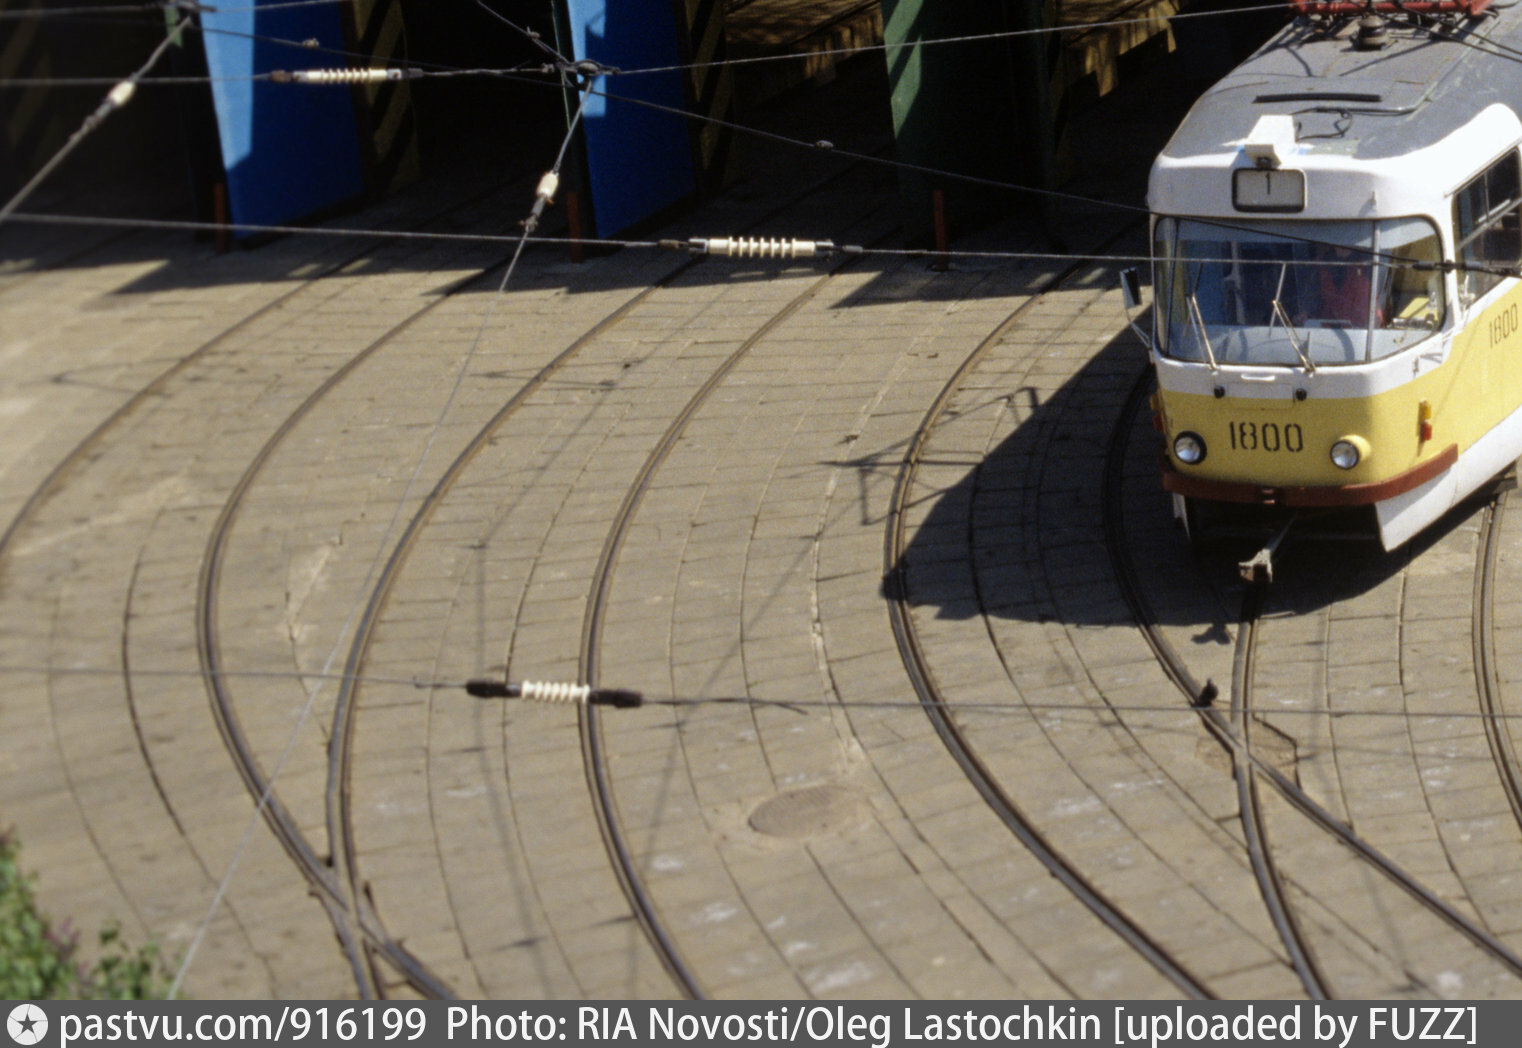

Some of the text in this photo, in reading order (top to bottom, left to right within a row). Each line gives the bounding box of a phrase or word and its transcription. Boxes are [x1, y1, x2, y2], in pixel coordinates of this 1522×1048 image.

[1265, 172, 1271, 195] 1
[1488, 303, 1519, 349] 1800
[1229, 421, 1304, 453] 1800
